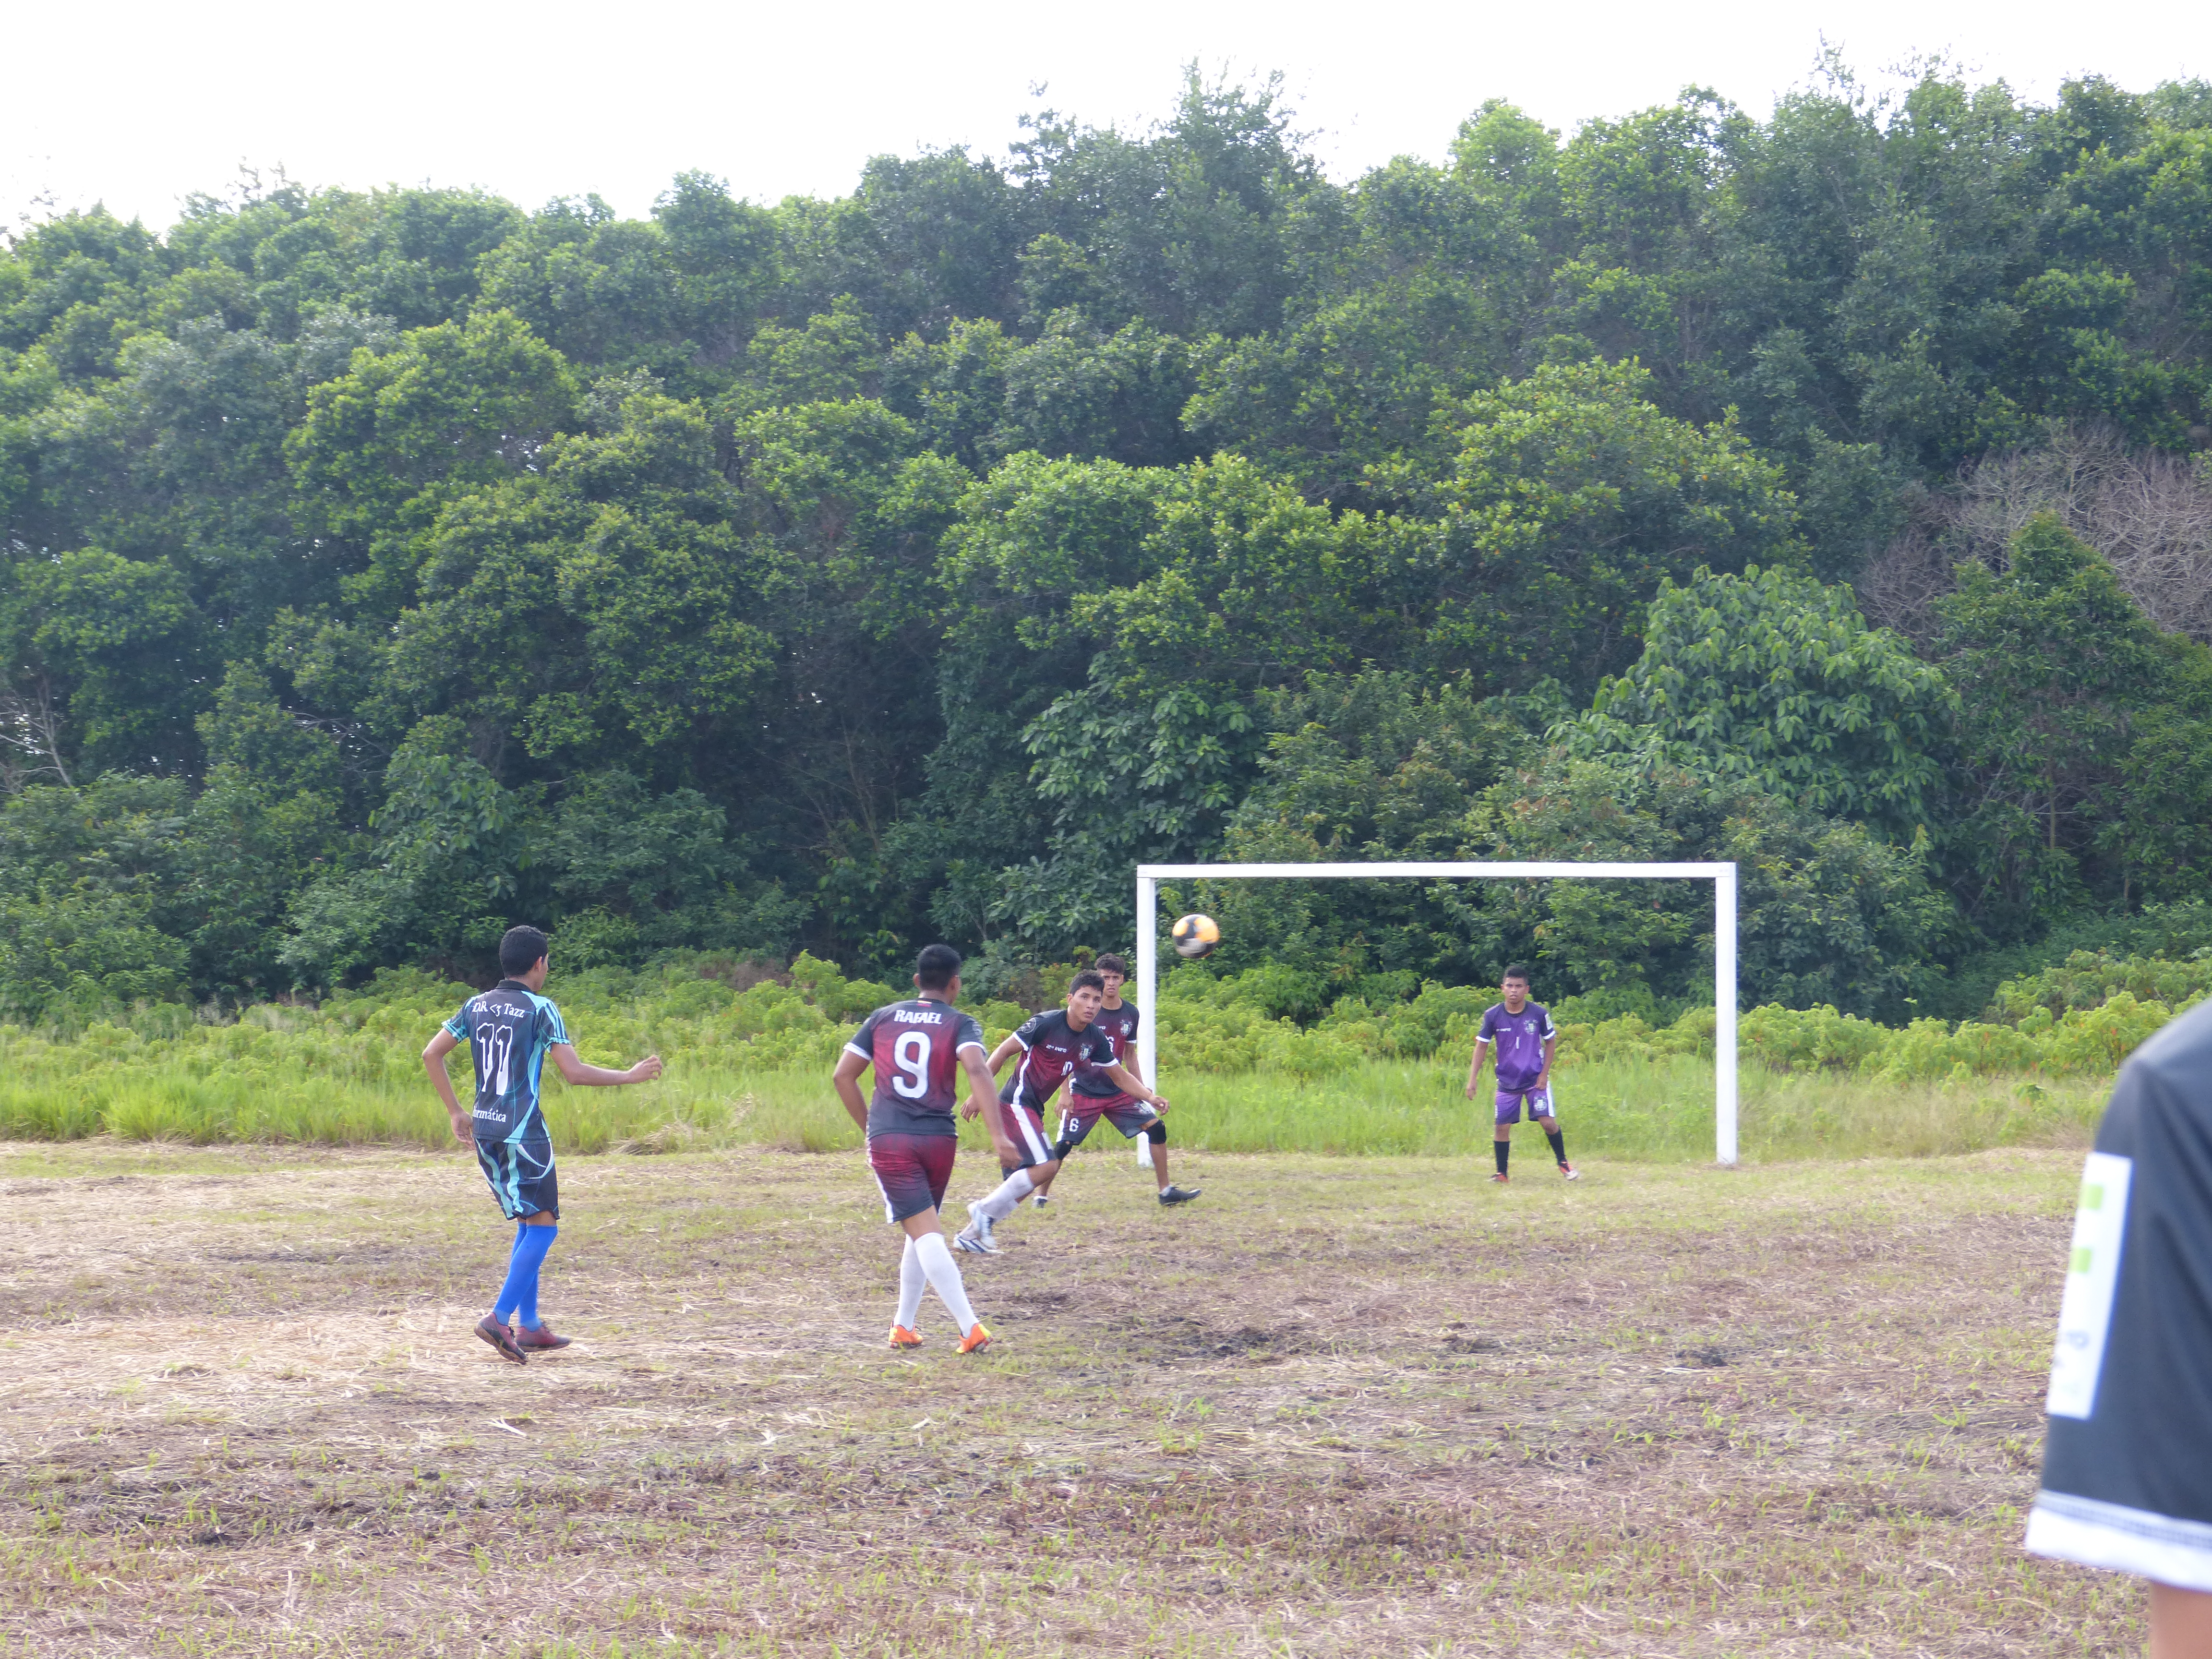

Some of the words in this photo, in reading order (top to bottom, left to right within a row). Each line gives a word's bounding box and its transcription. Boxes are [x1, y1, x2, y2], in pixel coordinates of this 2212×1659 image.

[472, 1001, 488, 1012] DR
[504, 1003, 525, 1018] Tazz
[894, 1010, 942, 1024] RAFAEL
[476, 1022, 513, 1096] 11
[892, 1031, 931, 1099] 9
[1069, 1118, 1079, 1131] 6
